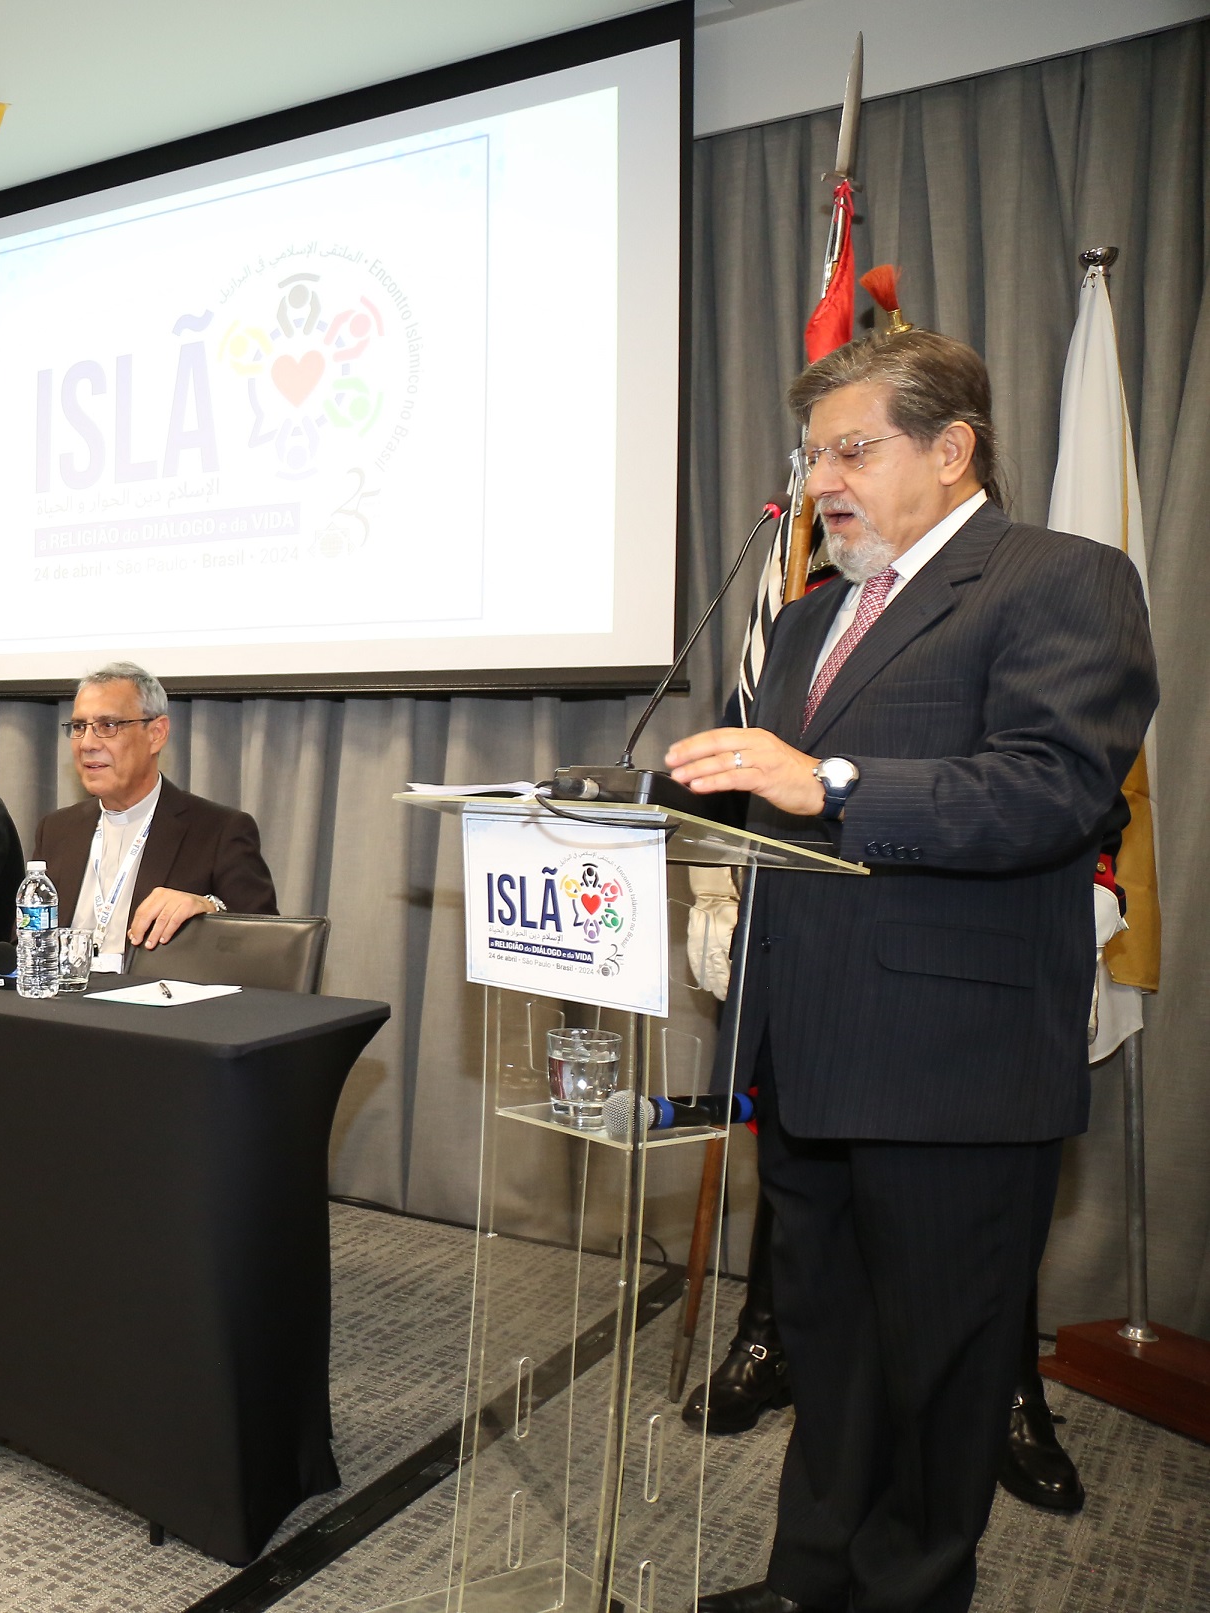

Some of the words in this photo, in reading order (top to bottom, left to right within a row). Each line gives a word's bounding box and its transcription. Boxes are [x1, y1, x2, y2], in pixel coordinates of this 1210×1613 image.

[367, 257, 413, 321] Encontro
[404, 321, 423, 394] Islâmico
[36, 309, 220, 494] ISLÃ
[400, 399, 415, 421] no
[374, 426, 410, 473] Brasil
[39, 539, 47, 552] a
[50, 523, 120, 550] RELIGIÃO
[122, 528, 140, 544] do
[142, 515, 216, 542] DIÁLOGO
[218, 521, 227, 534] e
[230, 516, 248, 533] da
[250, 509, 296, 532] VIDA
[34, 565, 50, 582] 24
[53, 563, 70, 581] de
[72, 560, 102, 579] abril
[116, 557, 142, 575] São
[146, 554, 188, 573] Paulo
[202, 551, 245, 570] Brasil
[260, 545, 299, 565] 2024
[615, 865, 633, 893] Encontro
[487, 866, 563, 932] ISLÃ
[621, 931, 634, 949] Brasil
[629, 922, 636, 931] no
[488, 952, 496, 960] 24
[496, 953, 504, 961] de
[504, 954, 518, 962] abril
[522, 957, 534, 965] São
[534, 958, 552, 968] Paulo
[556, 962, 574, 972] Brasil
[578, 966, 595, 975] 2024
[494, 940, 524, 951] RELIGIÃO
[532, 944, 562, 957] DIÁLOGO
[567, 951, 575, 959] da
[575, 952, 593, 962] VIDA
